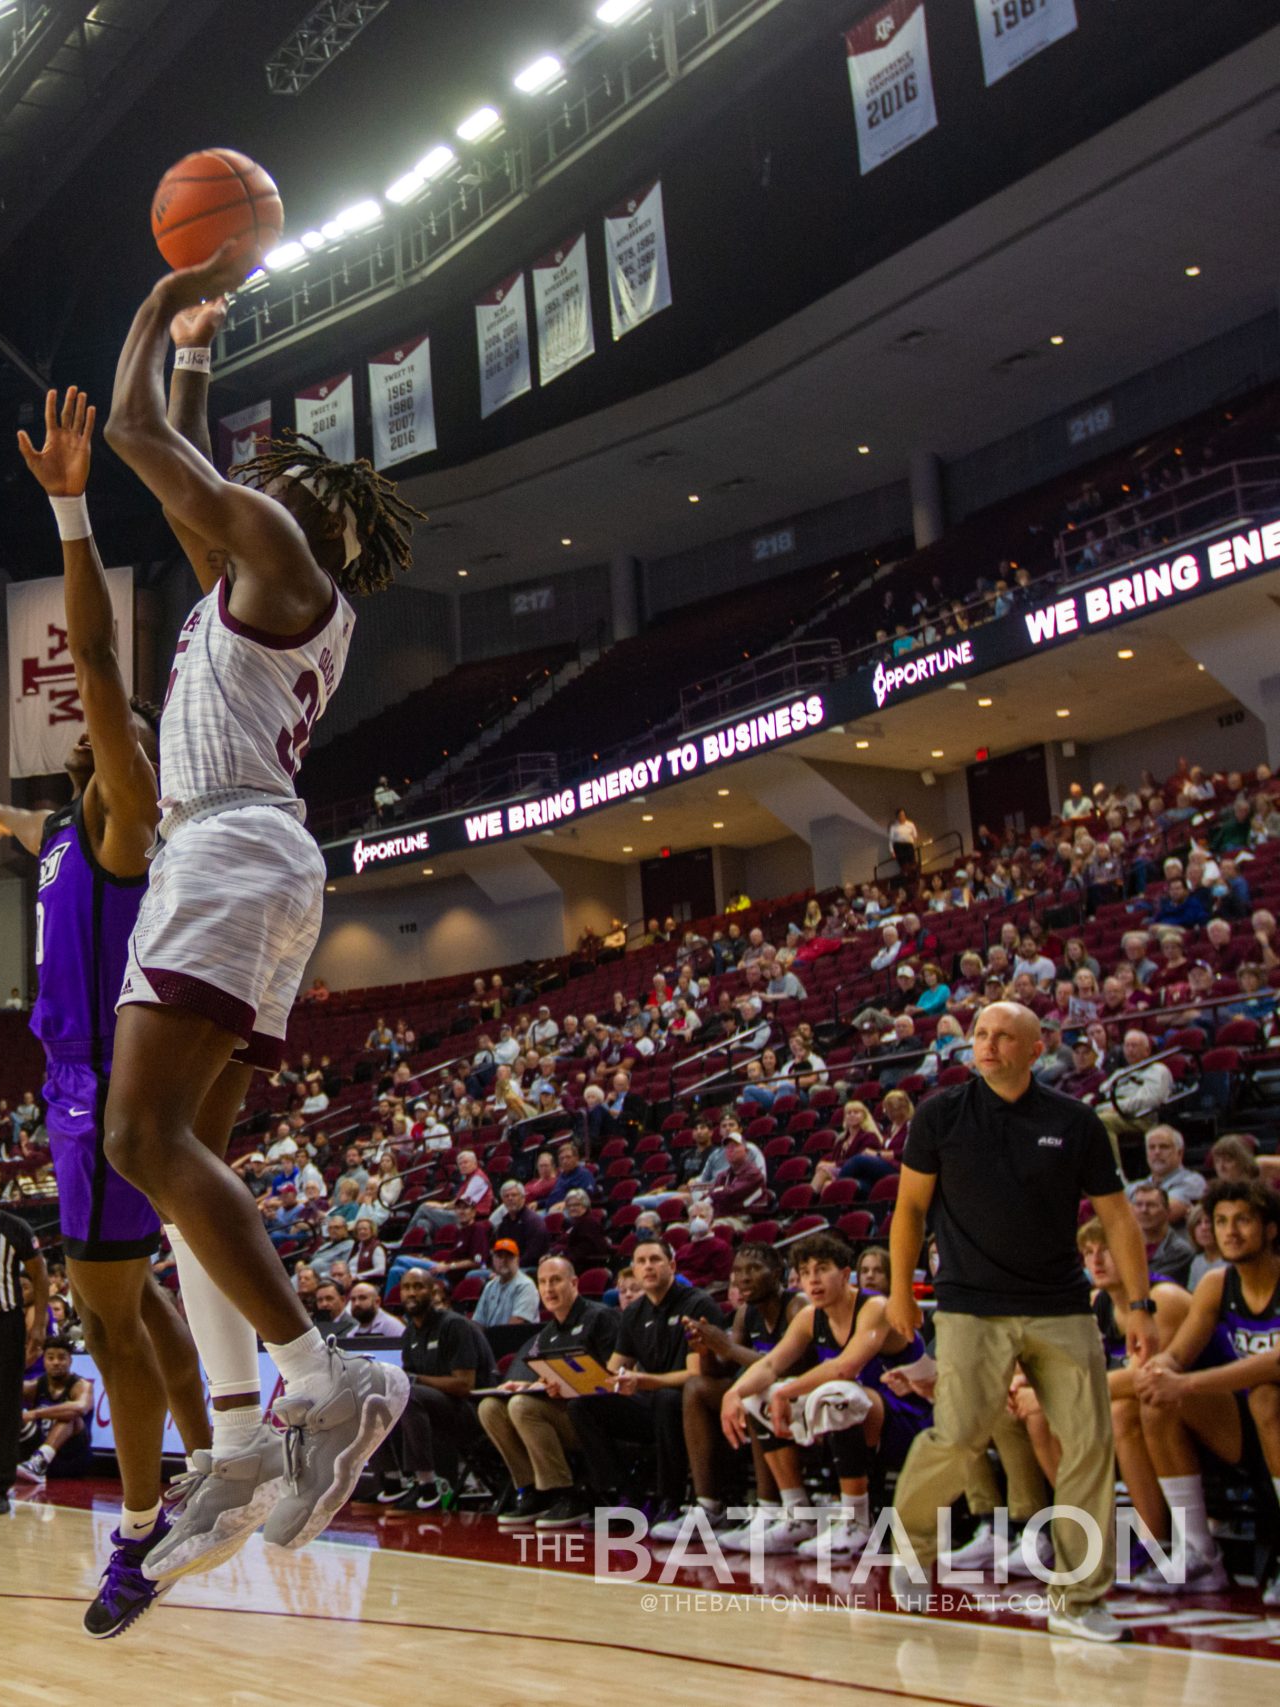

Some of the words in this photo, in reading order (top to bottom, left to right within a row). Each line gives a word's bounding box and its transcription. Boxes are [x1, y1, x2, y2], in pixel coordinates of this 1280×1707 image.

[866, 74, 918, 130] 2016
[386, 380, 414, 401] 1969
[387, 396, 414, 417] 1980
[388, 413, 415, 434] 2007
[1071, 407, 1111, 442] 219
[389, 429, 416, 452] 2016
[514, 590, 552, 616] 217
[1025, 597, 1078, 644] WE
[1084, 553, 1200, 624] BRING
[463, 811, 504, 843] WE
[506, 789, 577, 833] BRING
[578, 755, 662, 811] ENERGY
[666, 744, 699, 777] TO
[702, 695, 824, 766] BUSINESS
